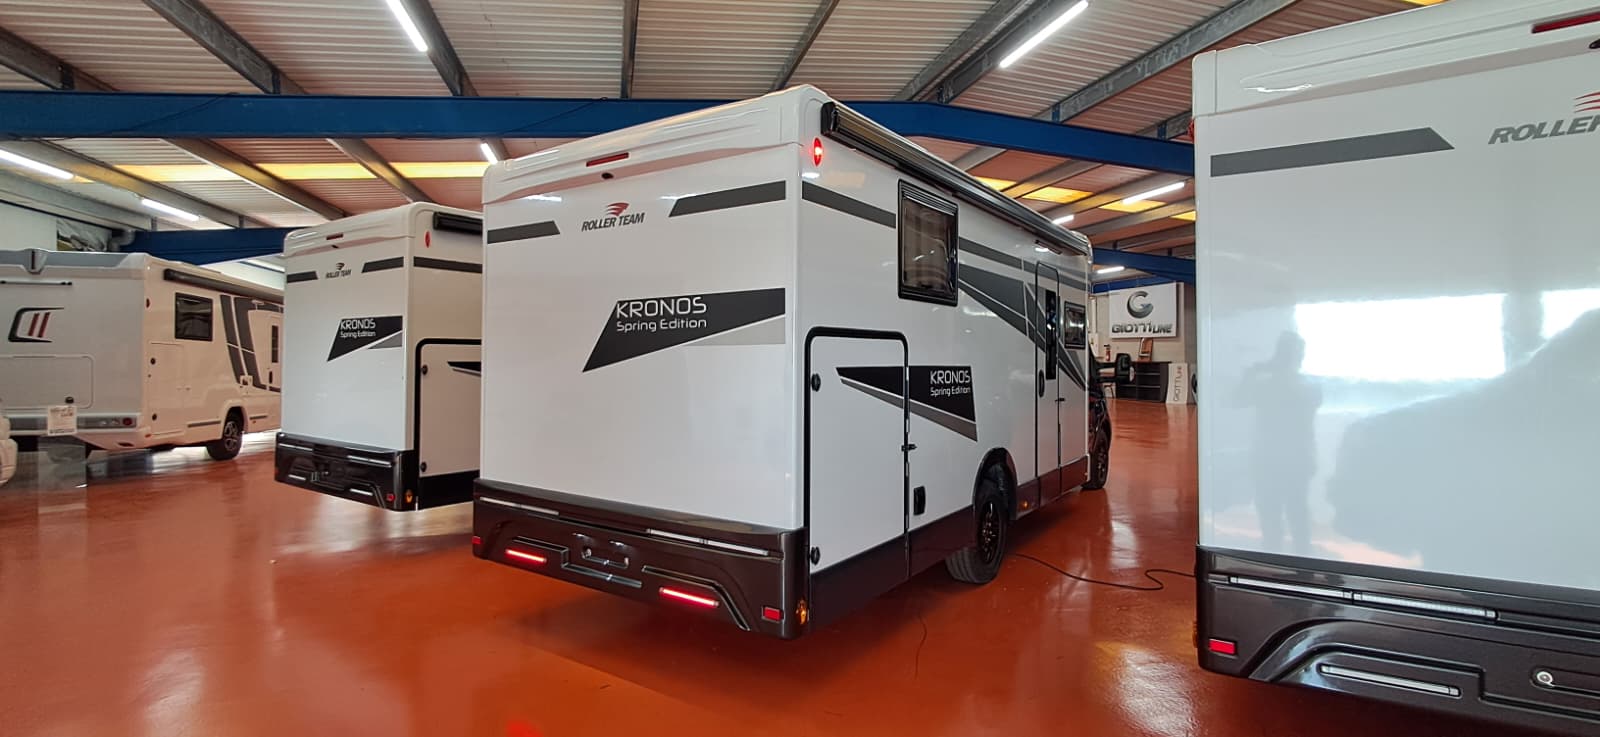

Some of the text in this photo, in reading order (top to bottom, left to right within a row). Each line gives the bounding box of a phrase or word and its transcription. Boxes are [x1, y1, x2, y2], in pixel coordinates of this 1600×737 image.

[581, 212, 645, 232] ROLLER TEAM
[616, 296, 707, 319] KRONOS
[340, 318, 376, 330] KRONOS
[616, 317, 707, 333] Spring Edition
[340, 331, 357, 339] Spring
[930, 369, 971, 384] KRONOS
[930, 386, 971, 397] Spring Edition
